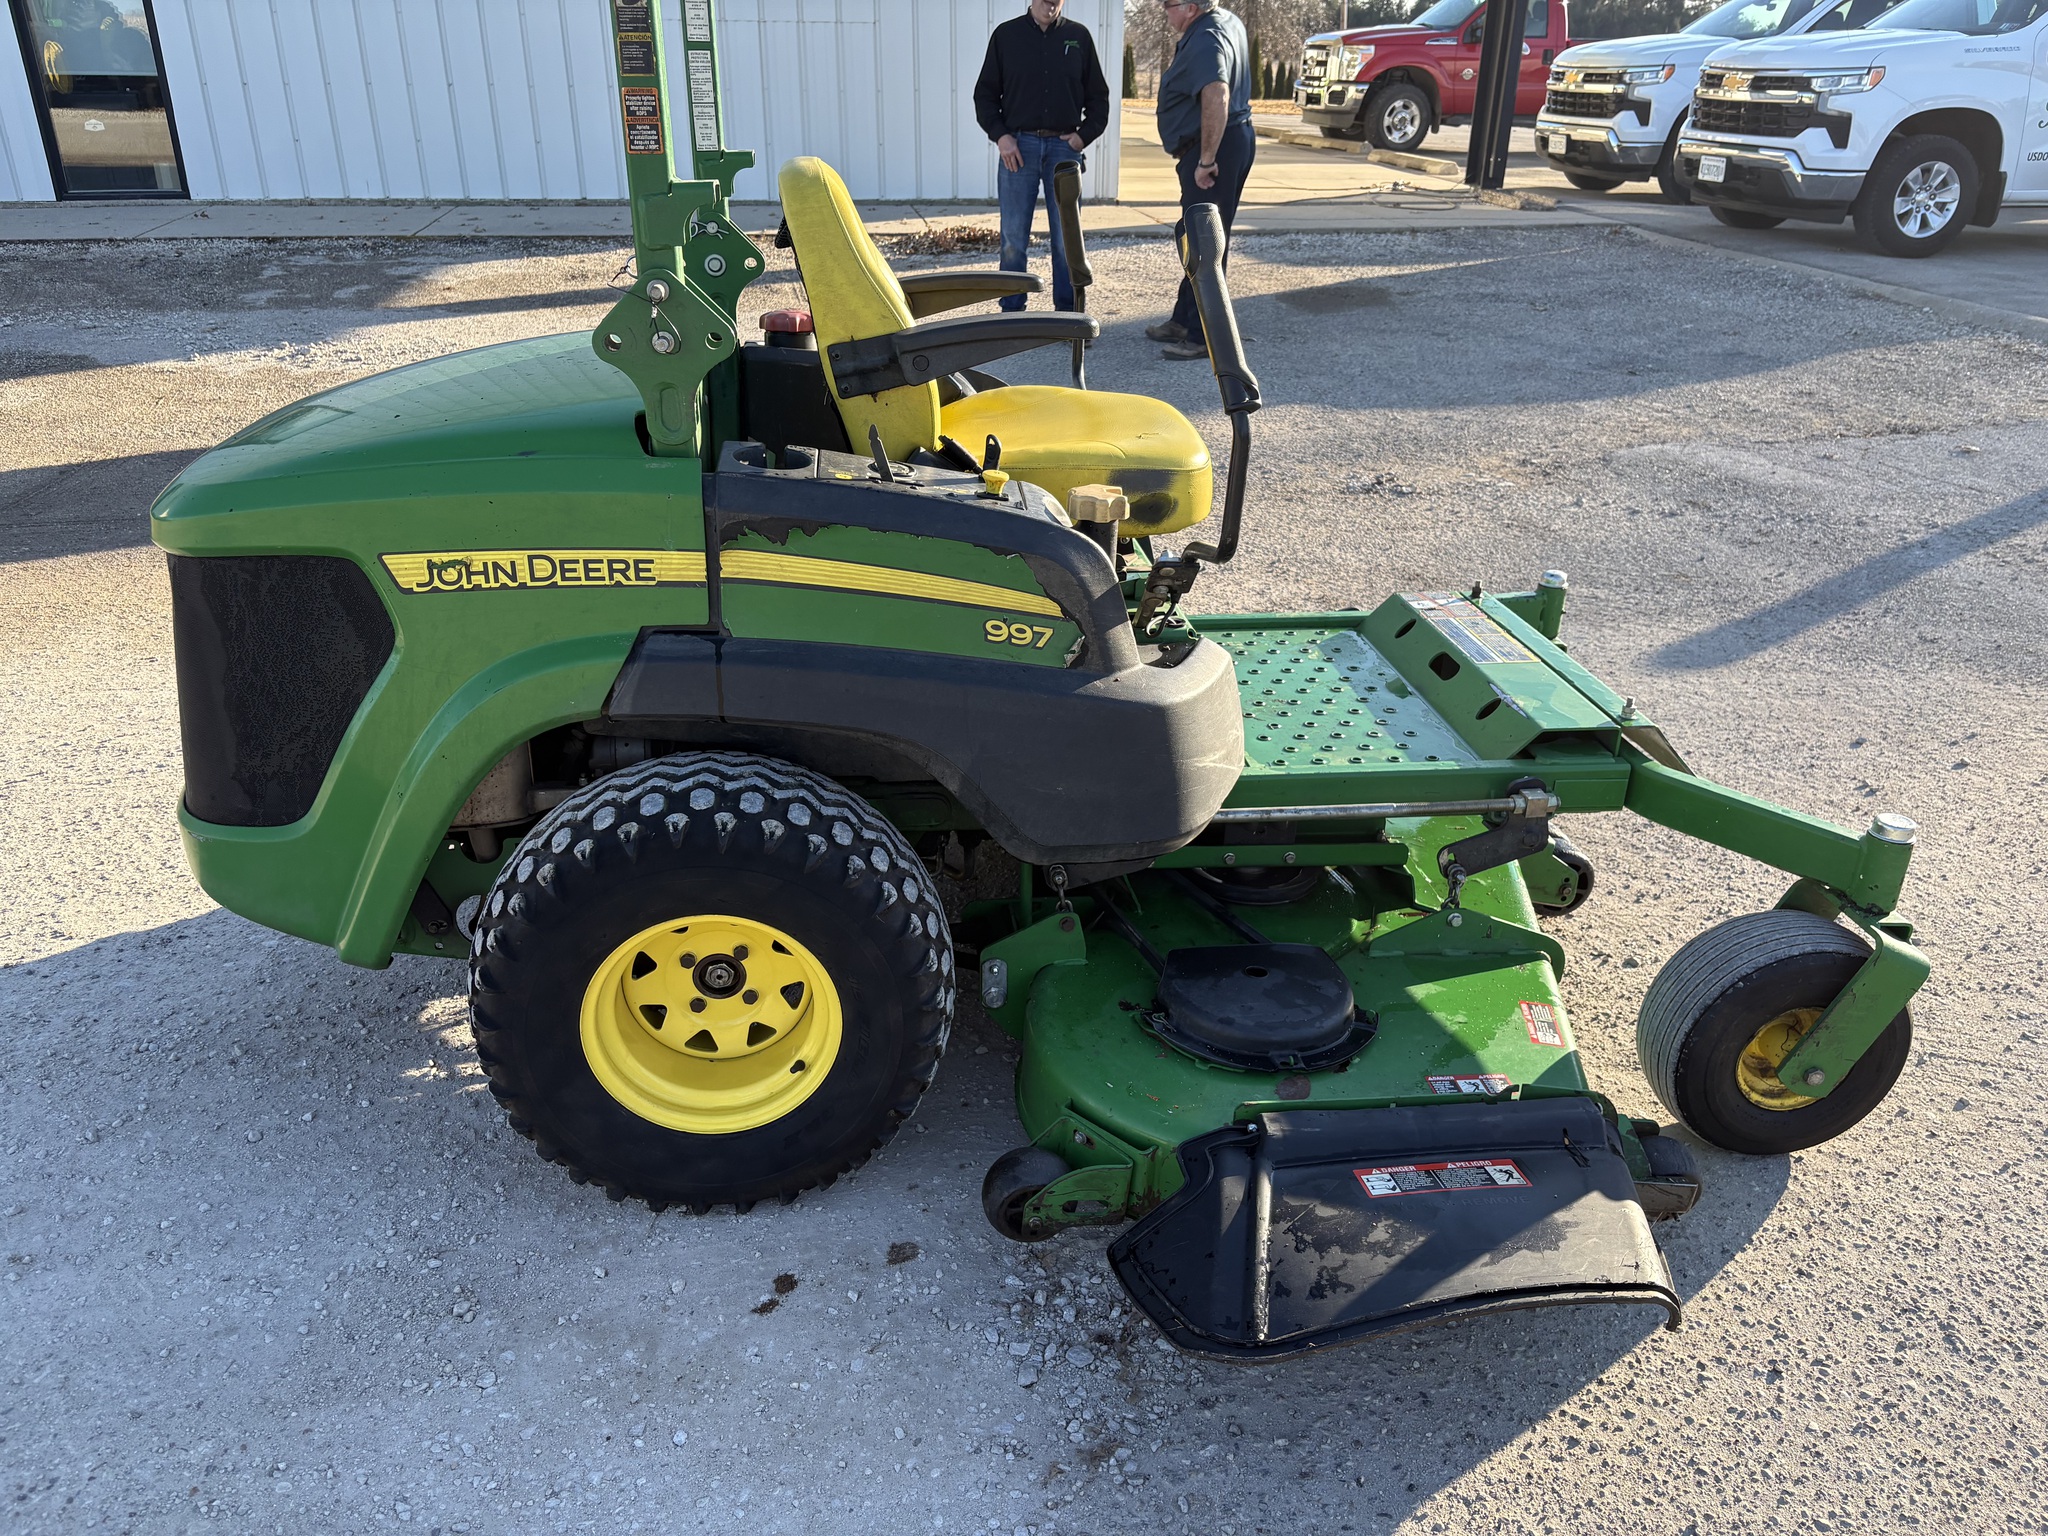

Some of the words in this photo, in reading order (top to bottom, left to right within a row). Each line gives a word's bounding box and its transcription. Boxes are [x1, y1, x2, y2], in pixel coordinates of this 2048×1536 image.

[415, 559, 519, 588] JOHN
[526, 553, 657, 584] DEERE
[984, 619, 1054, 649] 997
[1381, 1165, 1416, 1173] DANGER
[1455, 1160, 1492, 1168] PELIGRO
